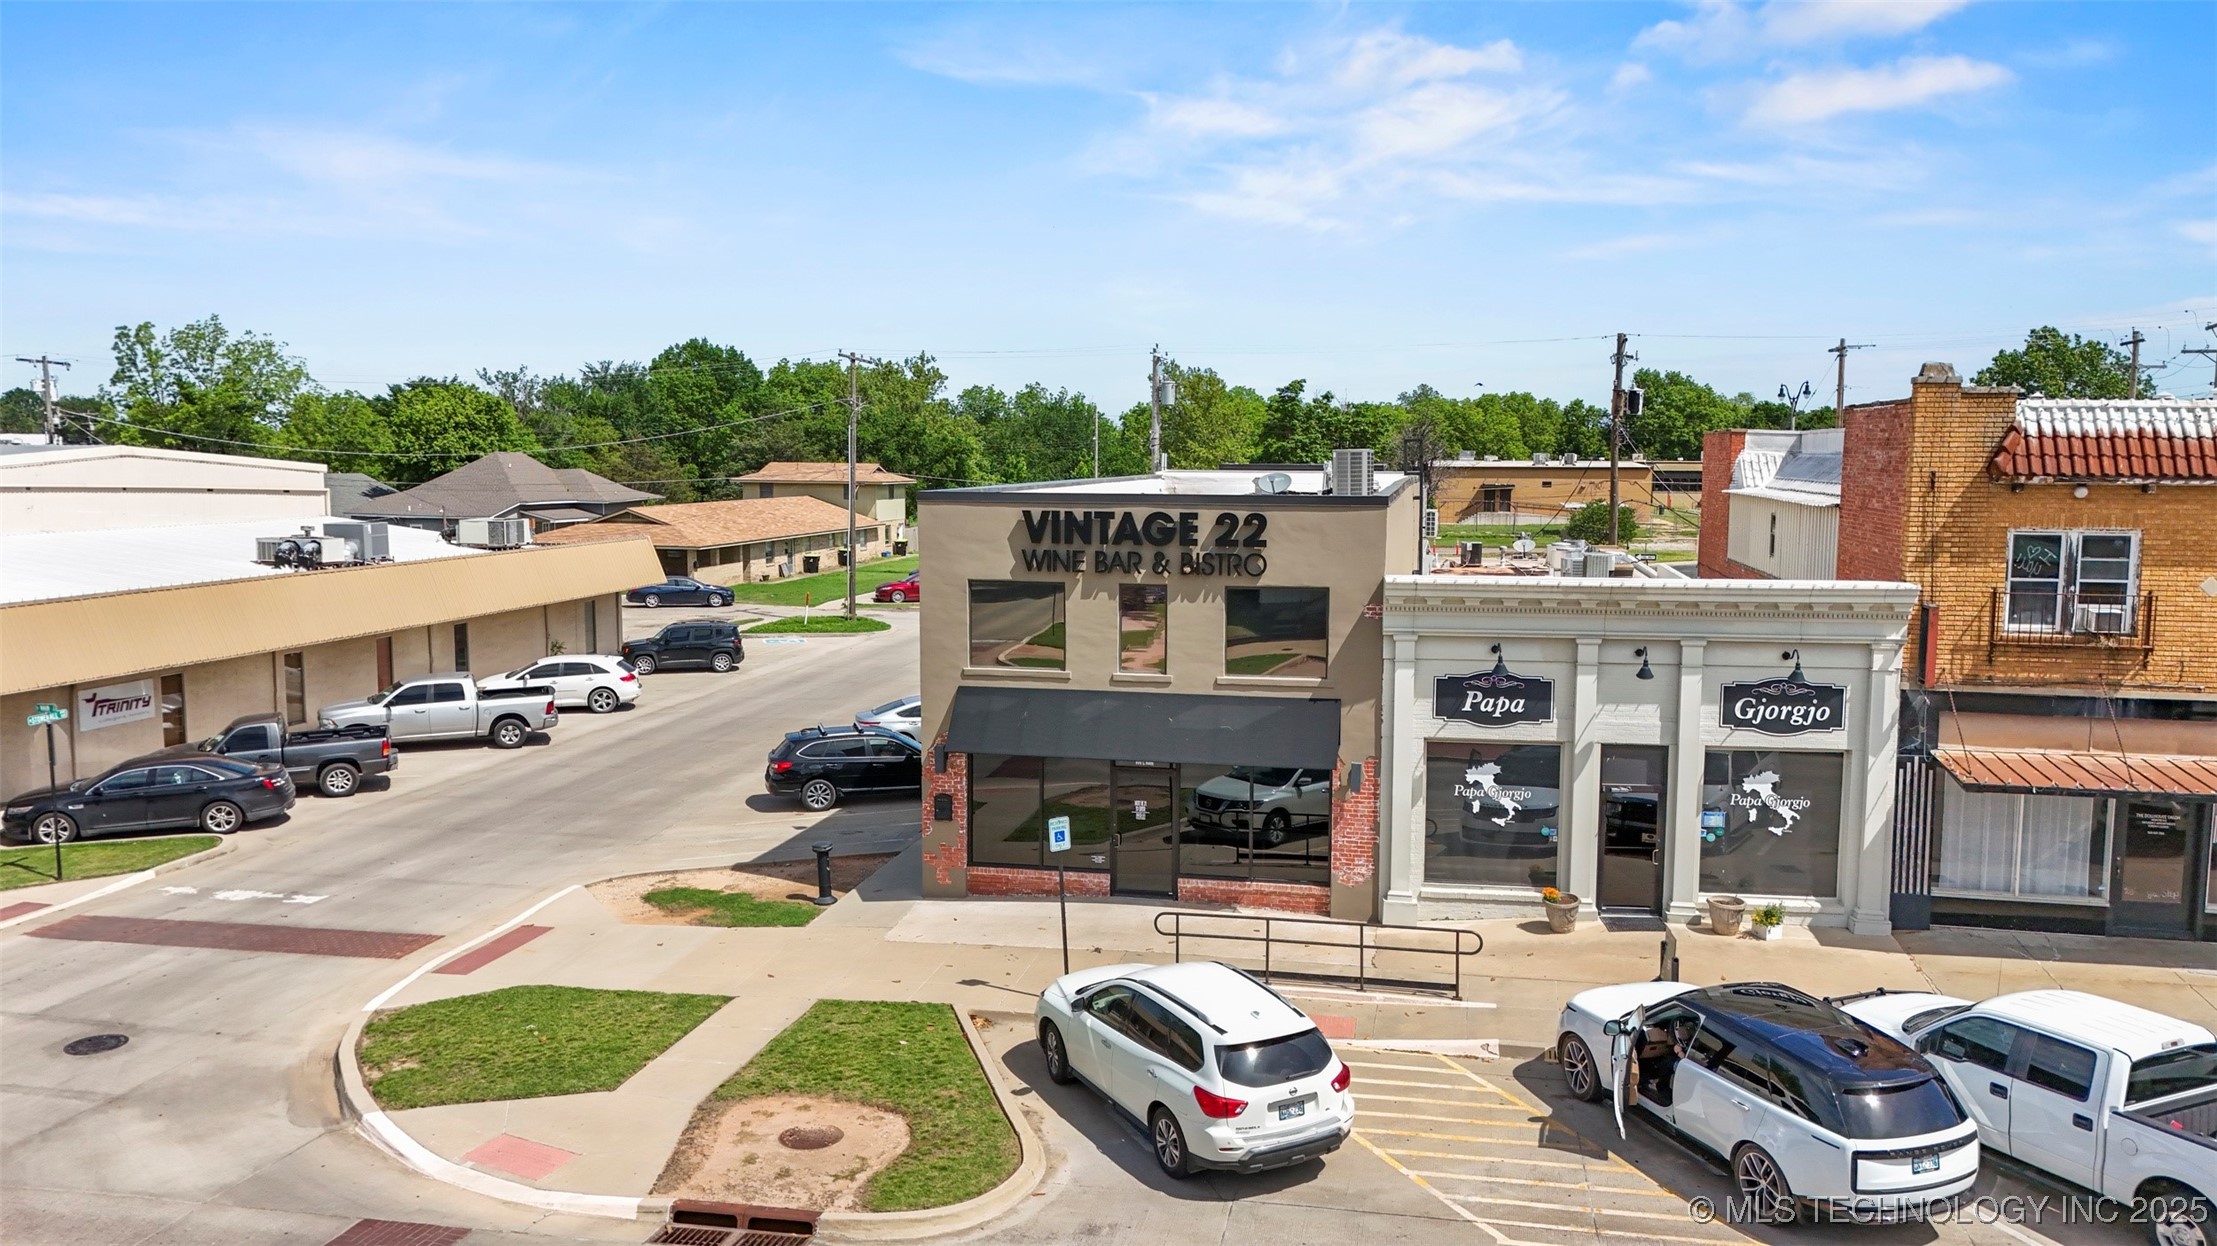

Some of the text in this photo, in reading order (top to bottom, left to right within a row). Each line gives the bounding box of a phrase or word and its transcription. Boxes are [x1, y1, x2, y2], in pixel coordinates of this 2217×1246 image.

[1022, 509, 1268, 547] VINTAGE 22
[1021, 549, 1268, 577] WINE BAR & BISTRO
[97, 695, 152, 716] TRINITY
[1461, 690, 1526, 718] Papa
[1734, 697, 1831, 726] Gjorgjo
[1454, 784, 1532, 801] Papa Gjorgjo
[1730, 793, 1811, 810] Papa Gjorgjo
